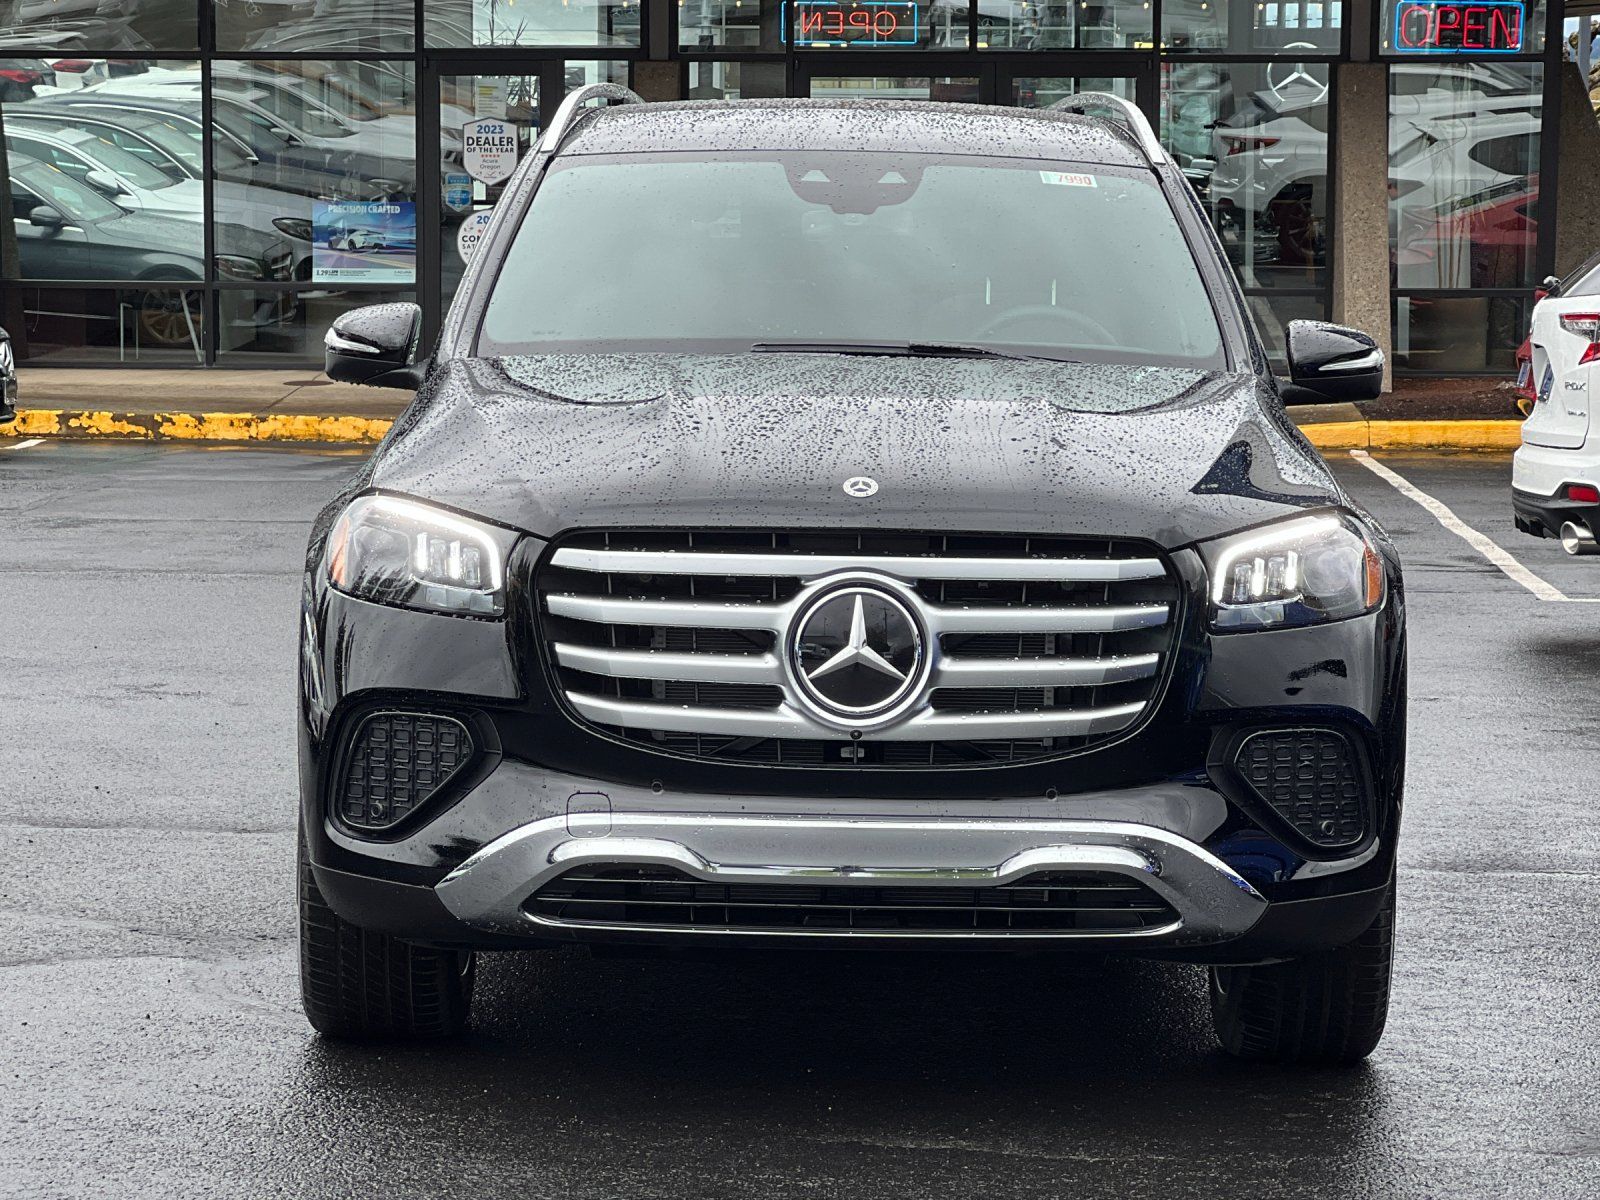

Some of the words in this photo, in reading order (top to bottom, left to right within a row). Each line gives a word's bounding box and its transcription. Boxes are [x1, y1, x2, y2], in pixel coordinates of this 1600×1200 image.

[1401, 6, 1520, 48] OPEN
[476, 124, 504, 134] 2023
[466, 136, 514, 146] DEALER
[327, 205, 367, 214] PRECISION
[368, 205, 401, 214] CRAFTED
